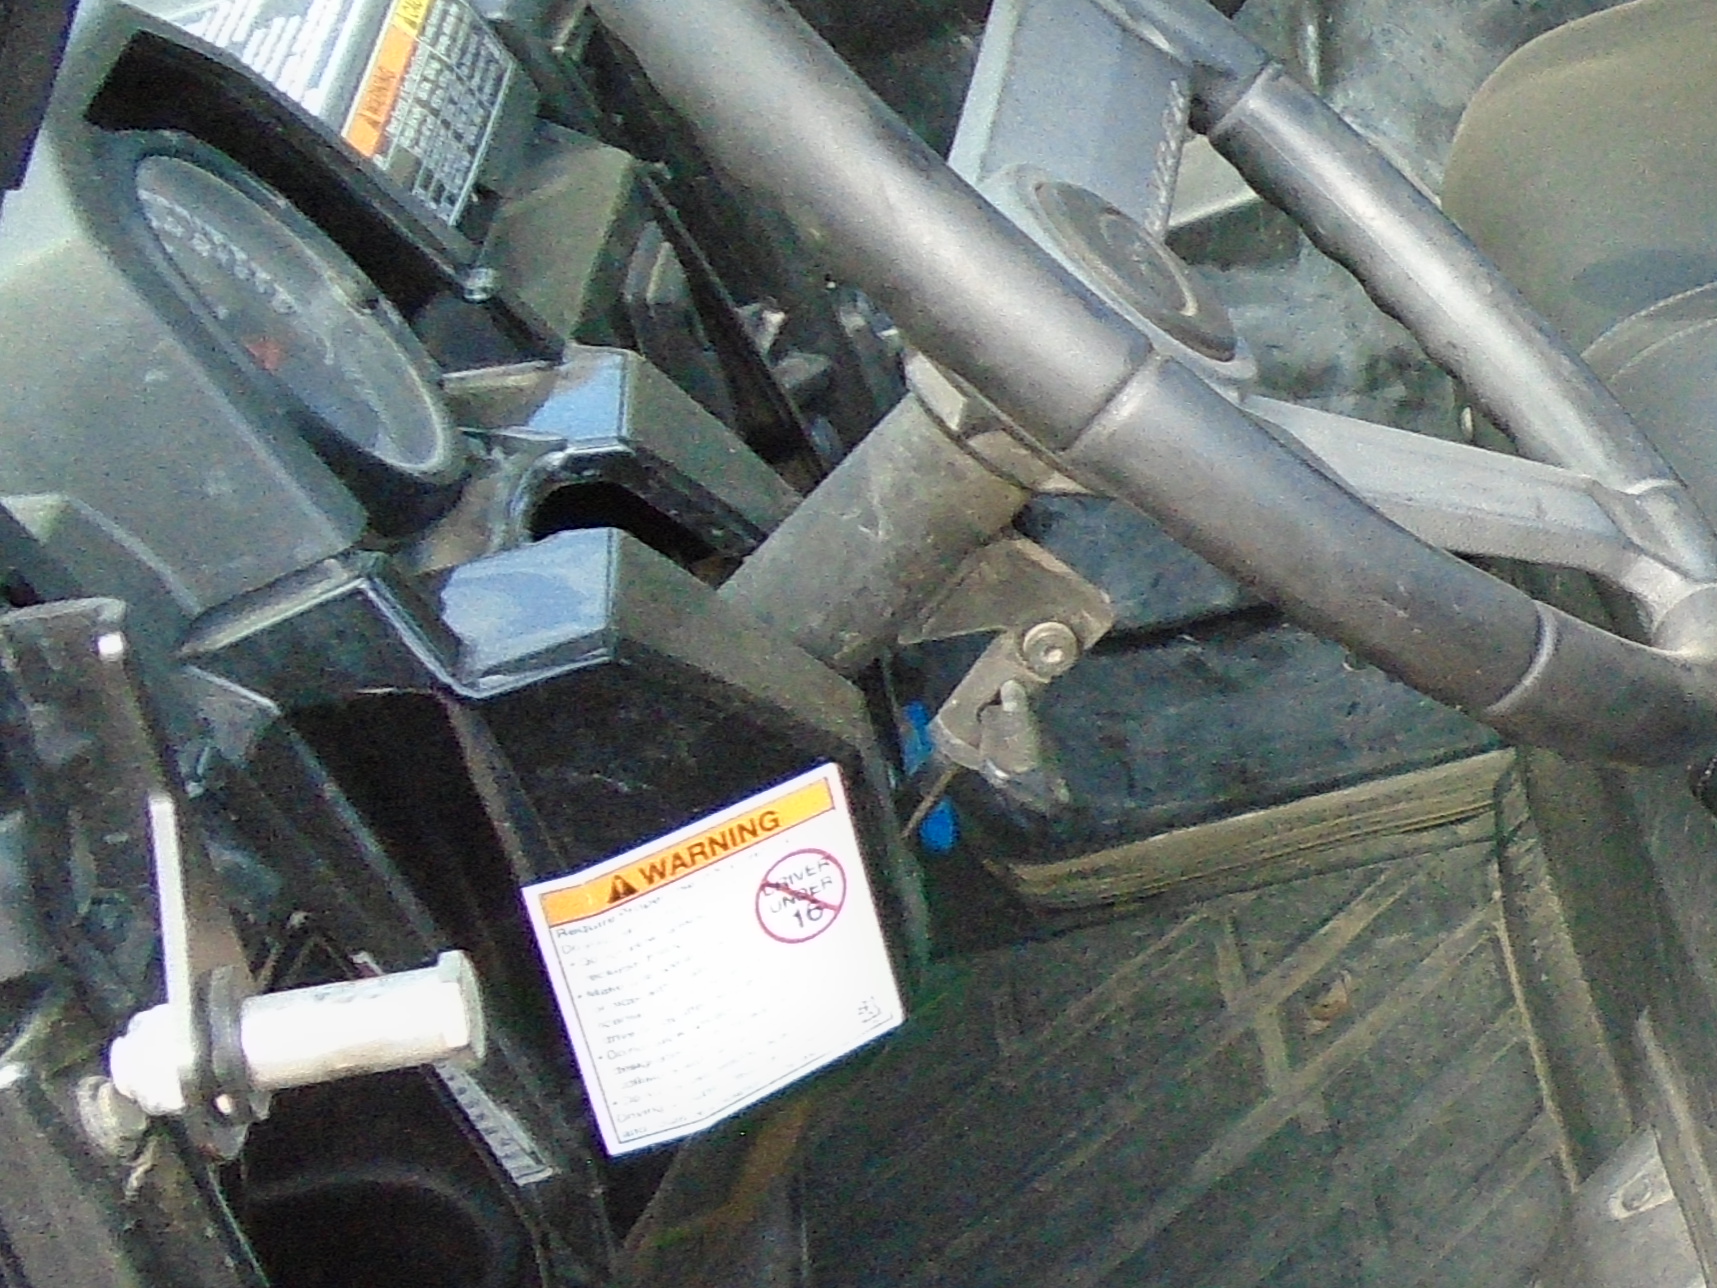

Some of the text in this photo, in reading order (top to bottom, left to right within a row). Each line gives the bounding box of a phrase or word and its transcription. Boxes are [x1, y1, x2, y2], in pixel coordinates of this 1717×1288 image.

[638, 809, 783, 888] WARNING
[763, 856, 831, 897] DRIVER
[770, 875, 833, 914] UNDER
[793, 903, 824, 929] 16
